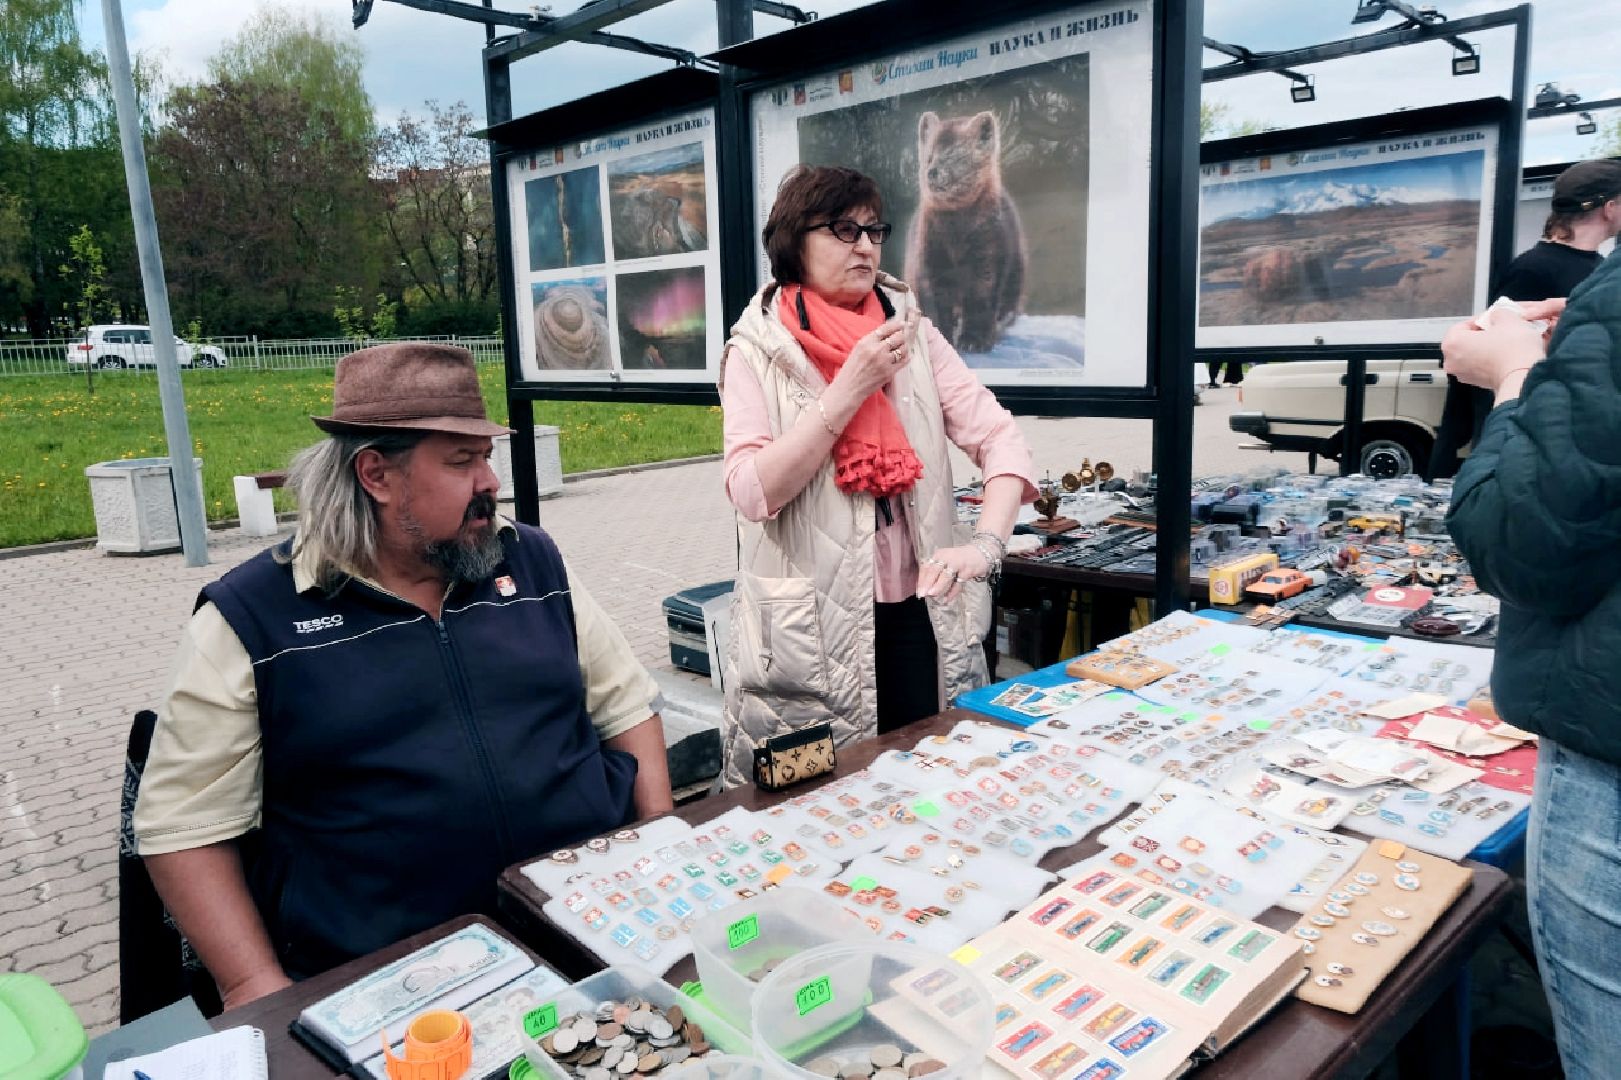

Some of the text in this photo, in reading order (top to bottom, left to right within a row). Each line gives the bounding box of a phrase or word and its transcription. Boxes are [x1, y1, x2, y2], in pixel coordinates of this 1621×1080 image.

[989, 9, 1139, 55] НАУКА И ЖИЗНЬ
[937, 48, 978, 68] Науки
[292, 614, 343, 630] TESCO
